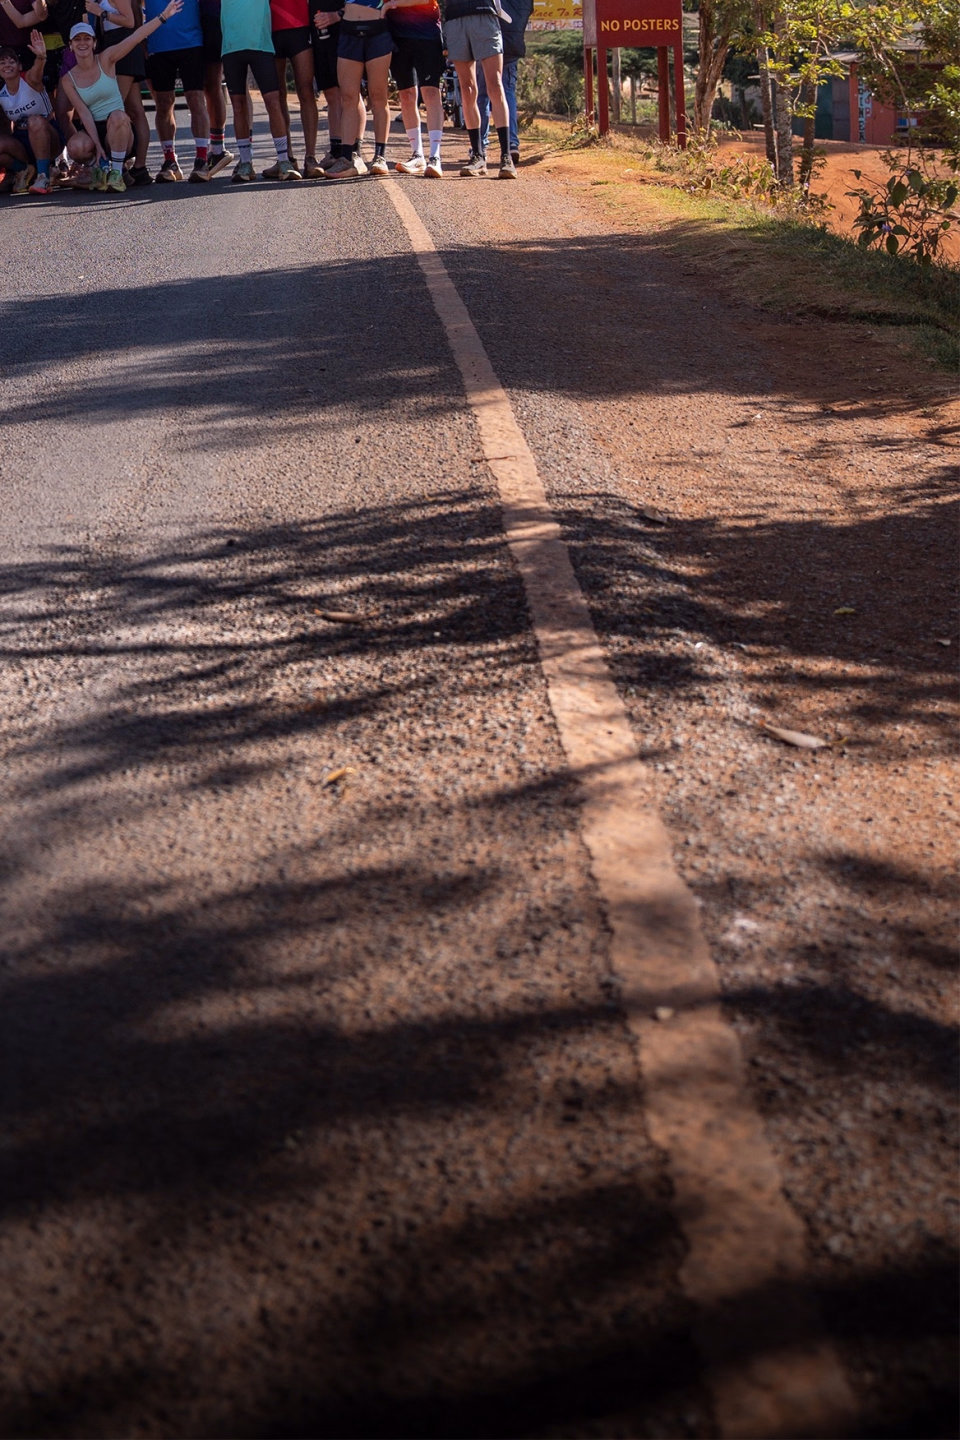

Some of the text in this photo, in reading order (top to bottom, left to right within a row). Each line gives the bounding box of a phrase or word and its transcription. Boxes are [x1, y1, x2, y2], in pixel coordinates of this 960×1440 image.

[532, 9, 553, 17] lace
[601, 19, 679, 32] NO POSTERS
